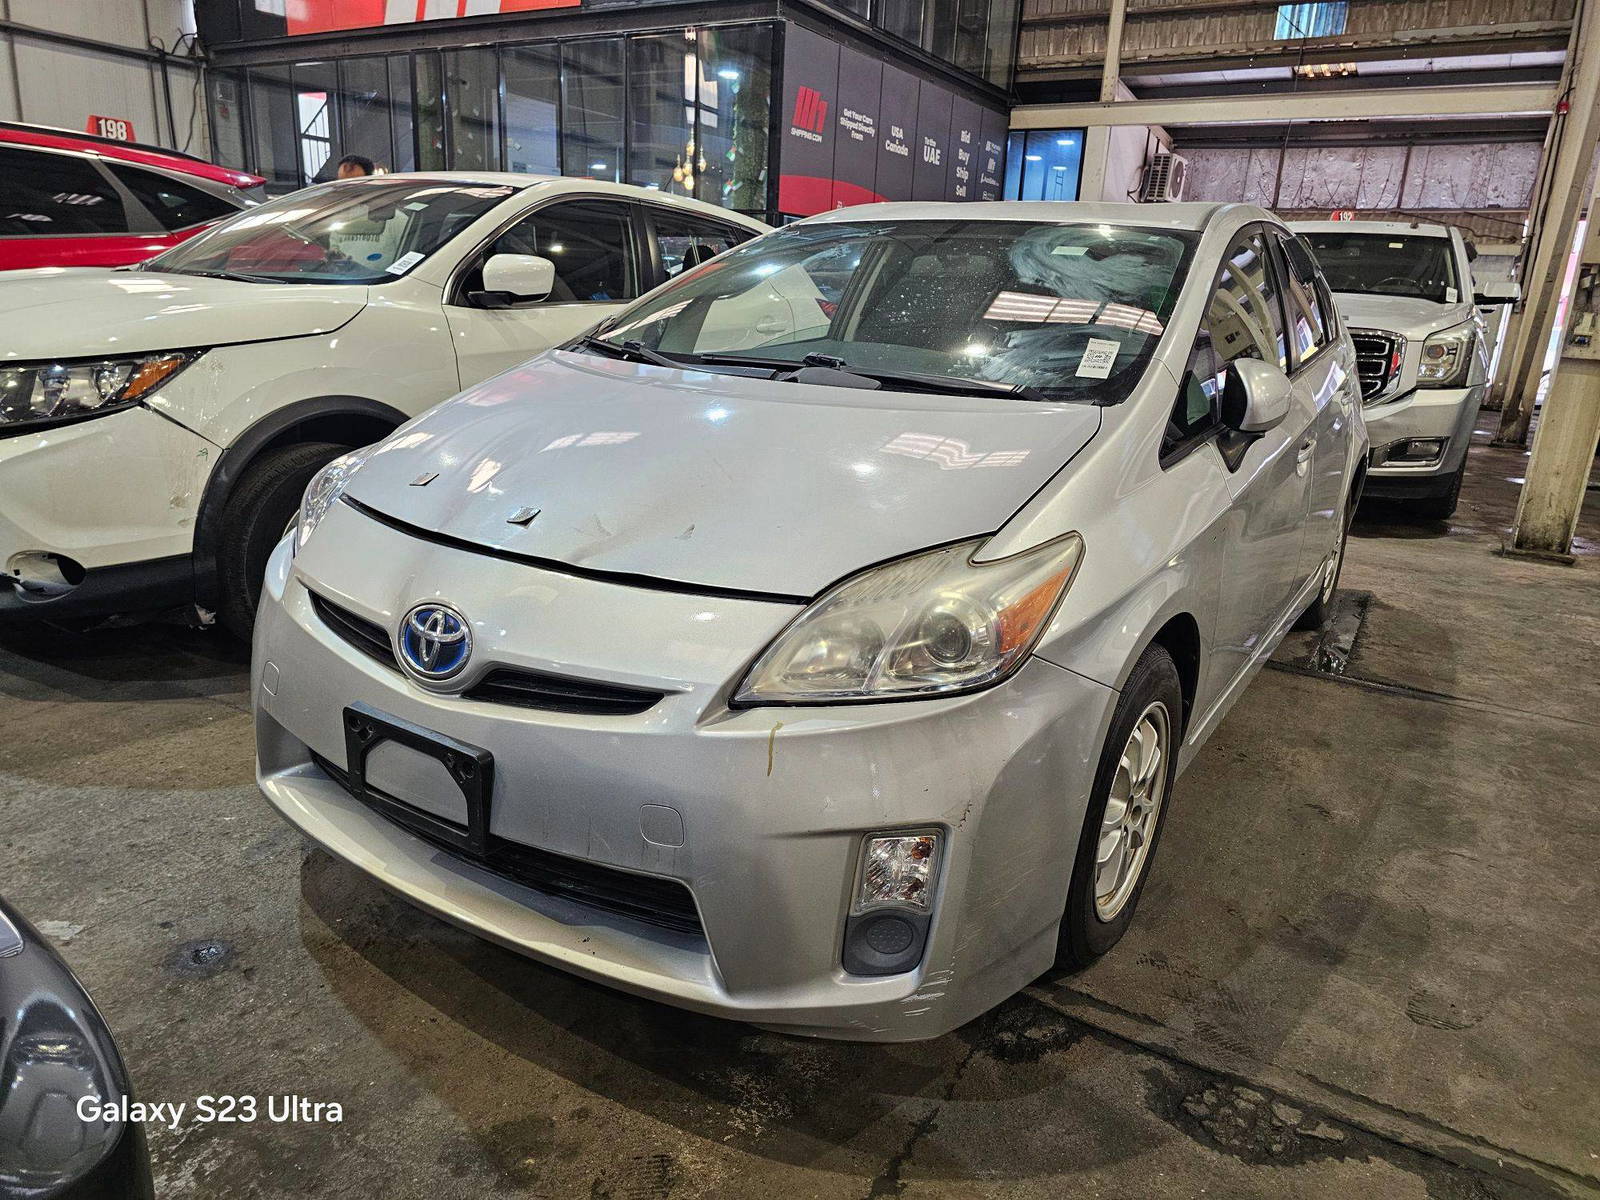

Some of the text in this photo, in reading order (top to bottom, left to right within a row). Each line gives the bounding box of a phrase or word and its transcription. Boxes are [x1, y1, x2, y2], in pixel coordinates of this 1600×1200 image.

[98, 118, 128, 141] 198
[851, 130, 864, 141] From
[891, 125, 904, 140] USA
[960, 130, 971, 144] Bid
[885, 139, 909, 156] Canada
[923, 145, 941, 165] UAE
[958, 148, 970, 166] Buy
[956, 166, 969, 183] Ship
[955, 184, 967, 198] Sell
